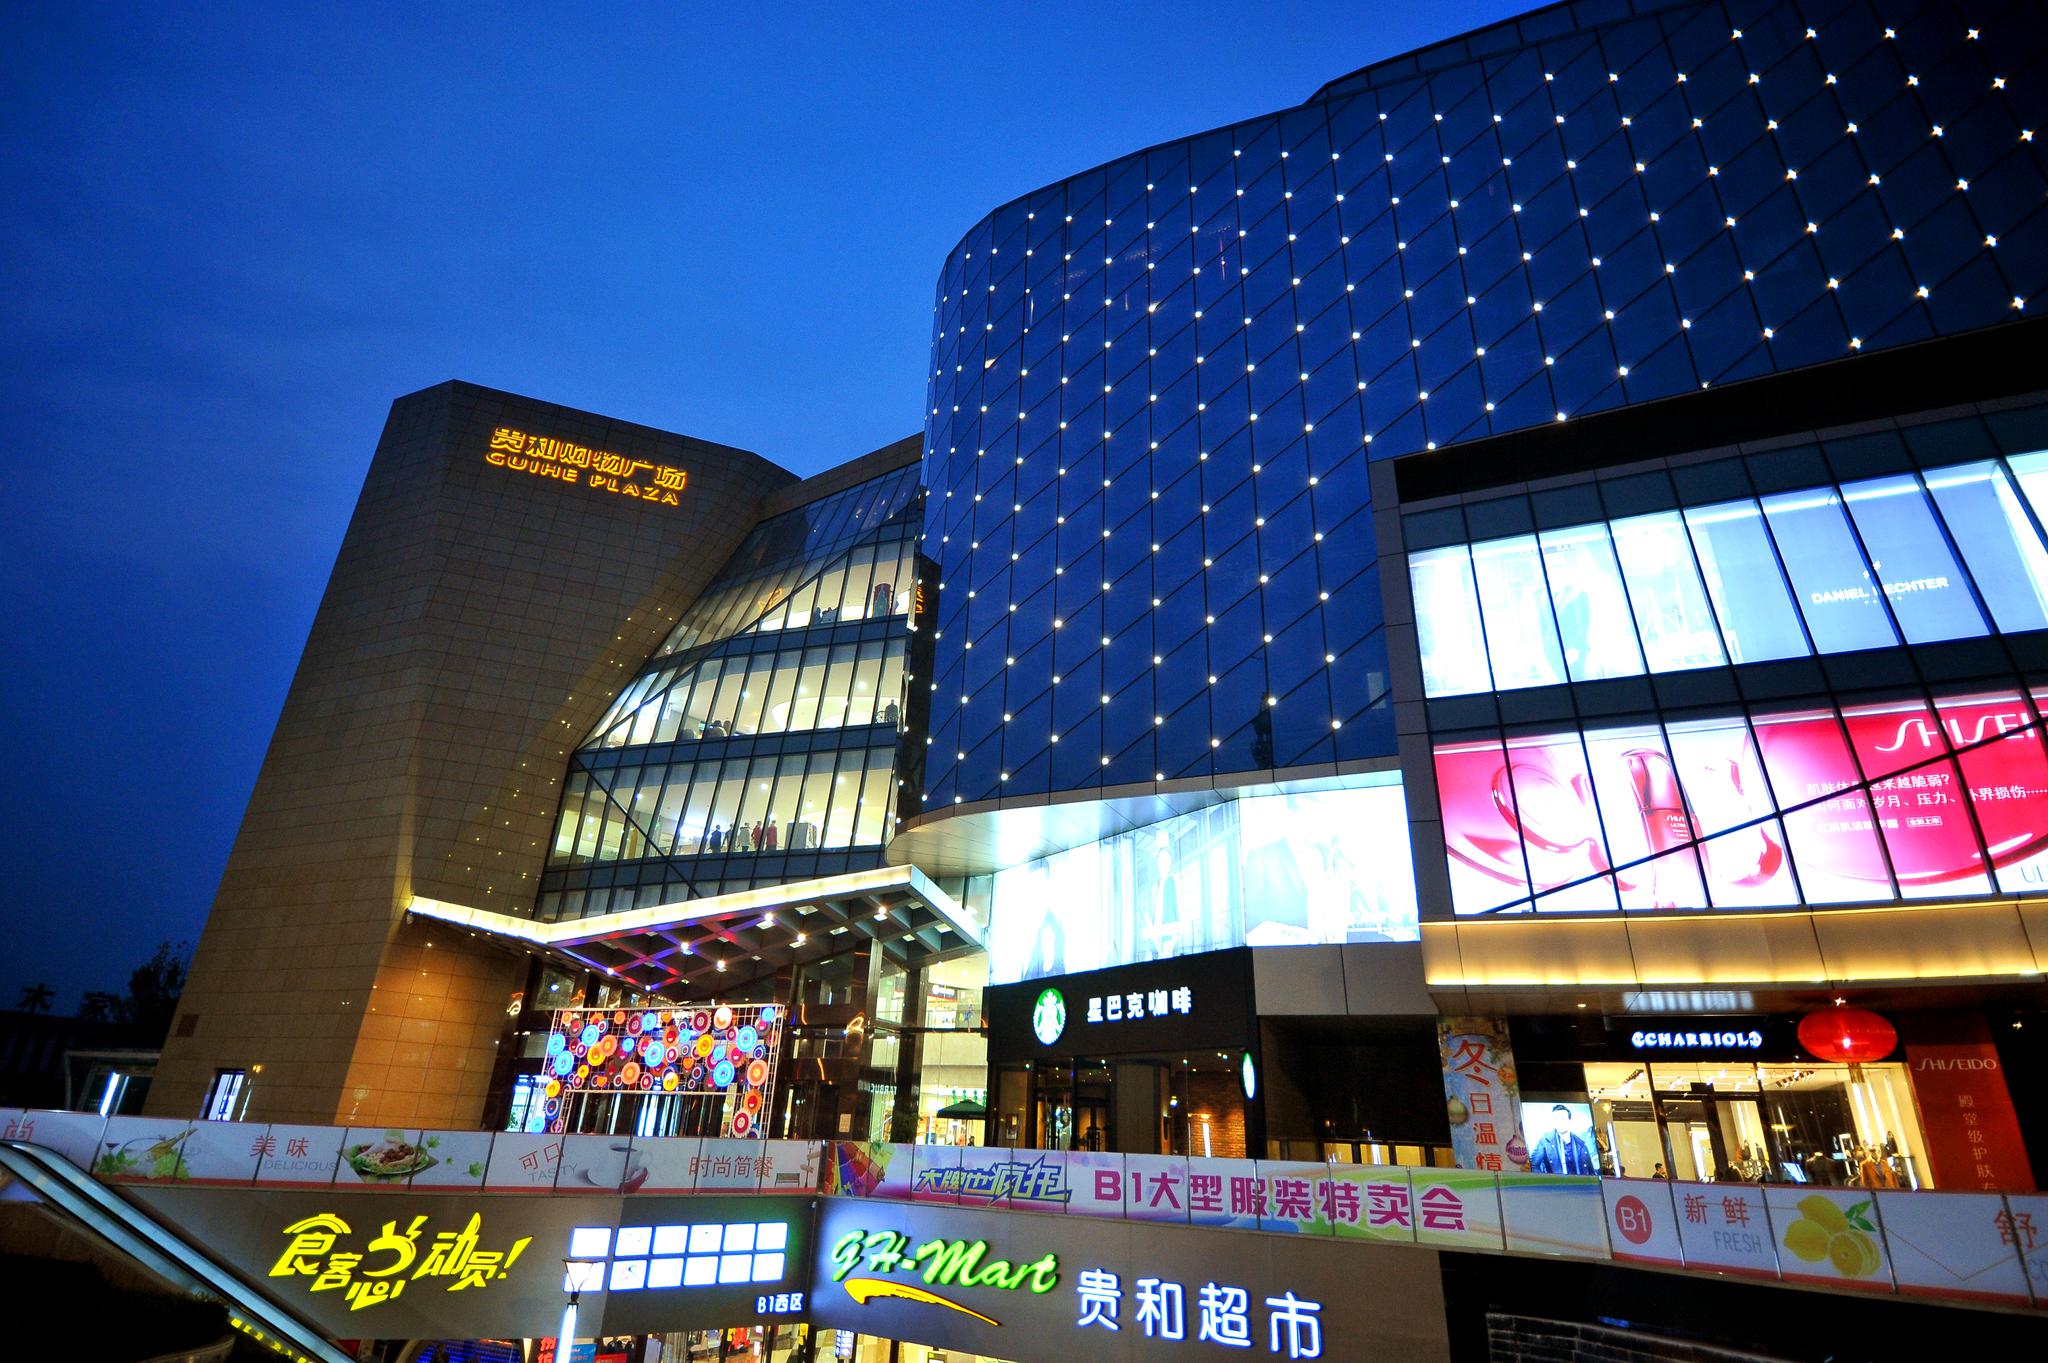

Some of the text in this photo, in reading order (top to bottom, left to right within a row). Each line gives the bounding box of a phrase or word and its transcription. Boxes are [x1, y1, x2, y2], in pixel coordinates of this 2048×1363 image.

[489, 427, 688, 490] 贵和购物广场
[485, 451, 680, 506] GUIHE PLAZA
[1811, 587, 1870, 605] DANIEL
[1874, 710, 2048, 752] SHISEI
[1087, 986, 1192, 1023] 星巴克咖啡
[1914, 1058, 1998, 1072] SHISEIDO
[1452, 1039, 1503, 1172] 冬日温情
[250, 1135, 310, 1158] 美味
[518, 1142, 565, 1170] 可口
[263, 1160, 338, 1172] DELICIOUS
[528, 1162, 578, 1183] TASTY
[688, 1153, 775, 1179] 时尚简餐
[1094, 1169, 1465, 1231] B1大型服装特卖会
[1684, 1193, 1750, 1229] 新鲜
[1620, 1206, 1648, 1233] B1
[1713, 1231, 1763, 1254] FRESH
[756, 1291, 804, 1315] B1西区
[831, 1229, 1322, 1361] GH-Mart 贵和超市
